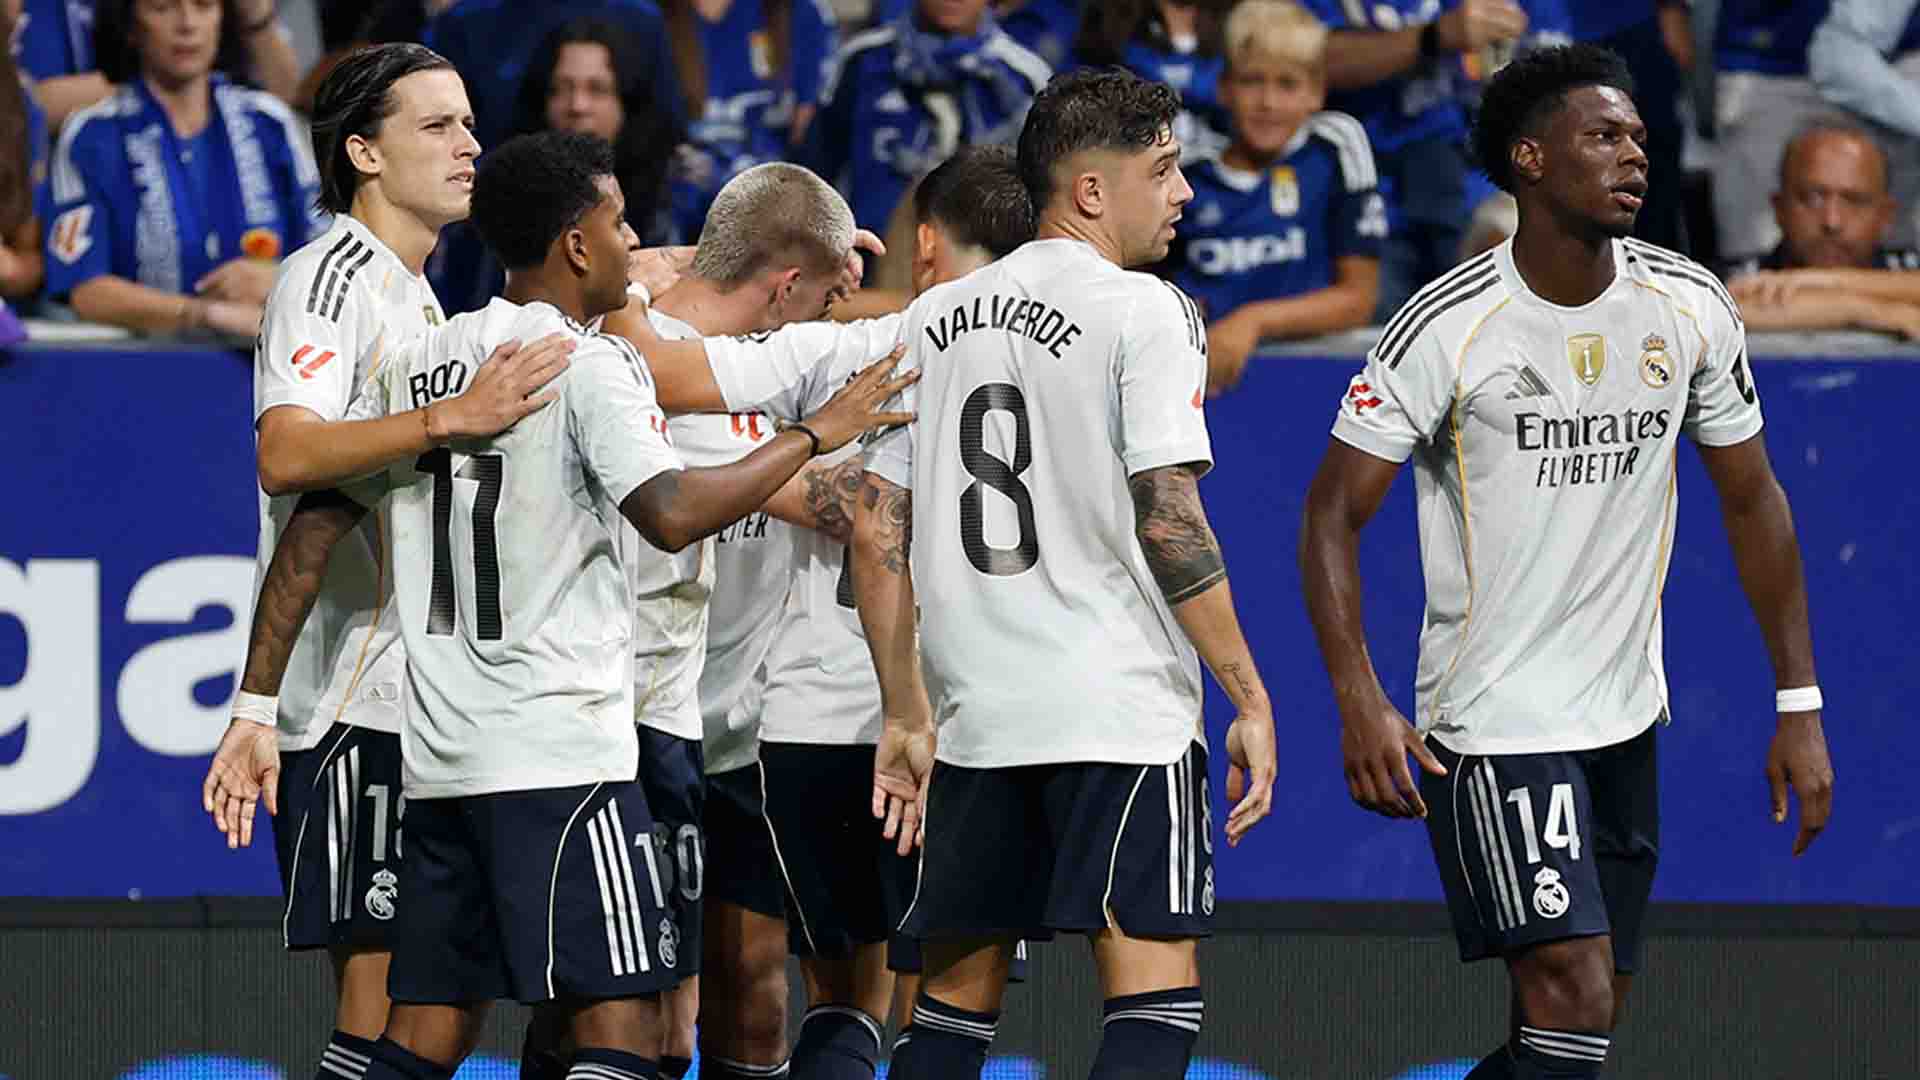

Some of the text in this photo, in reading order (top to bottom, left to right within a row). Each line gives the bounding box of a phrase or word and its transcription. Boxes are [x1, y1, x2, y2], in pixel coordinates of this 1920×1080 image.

[925, 295, 1081, 358] VALVERDE
[1514, 408, 1670, 450] Emirates
[960, 383, 1038, 577] 8
[415, 445, 504, 641] 11
[365, 784, 406, 860] 1
[1506, 783, 1581, 864] 14
